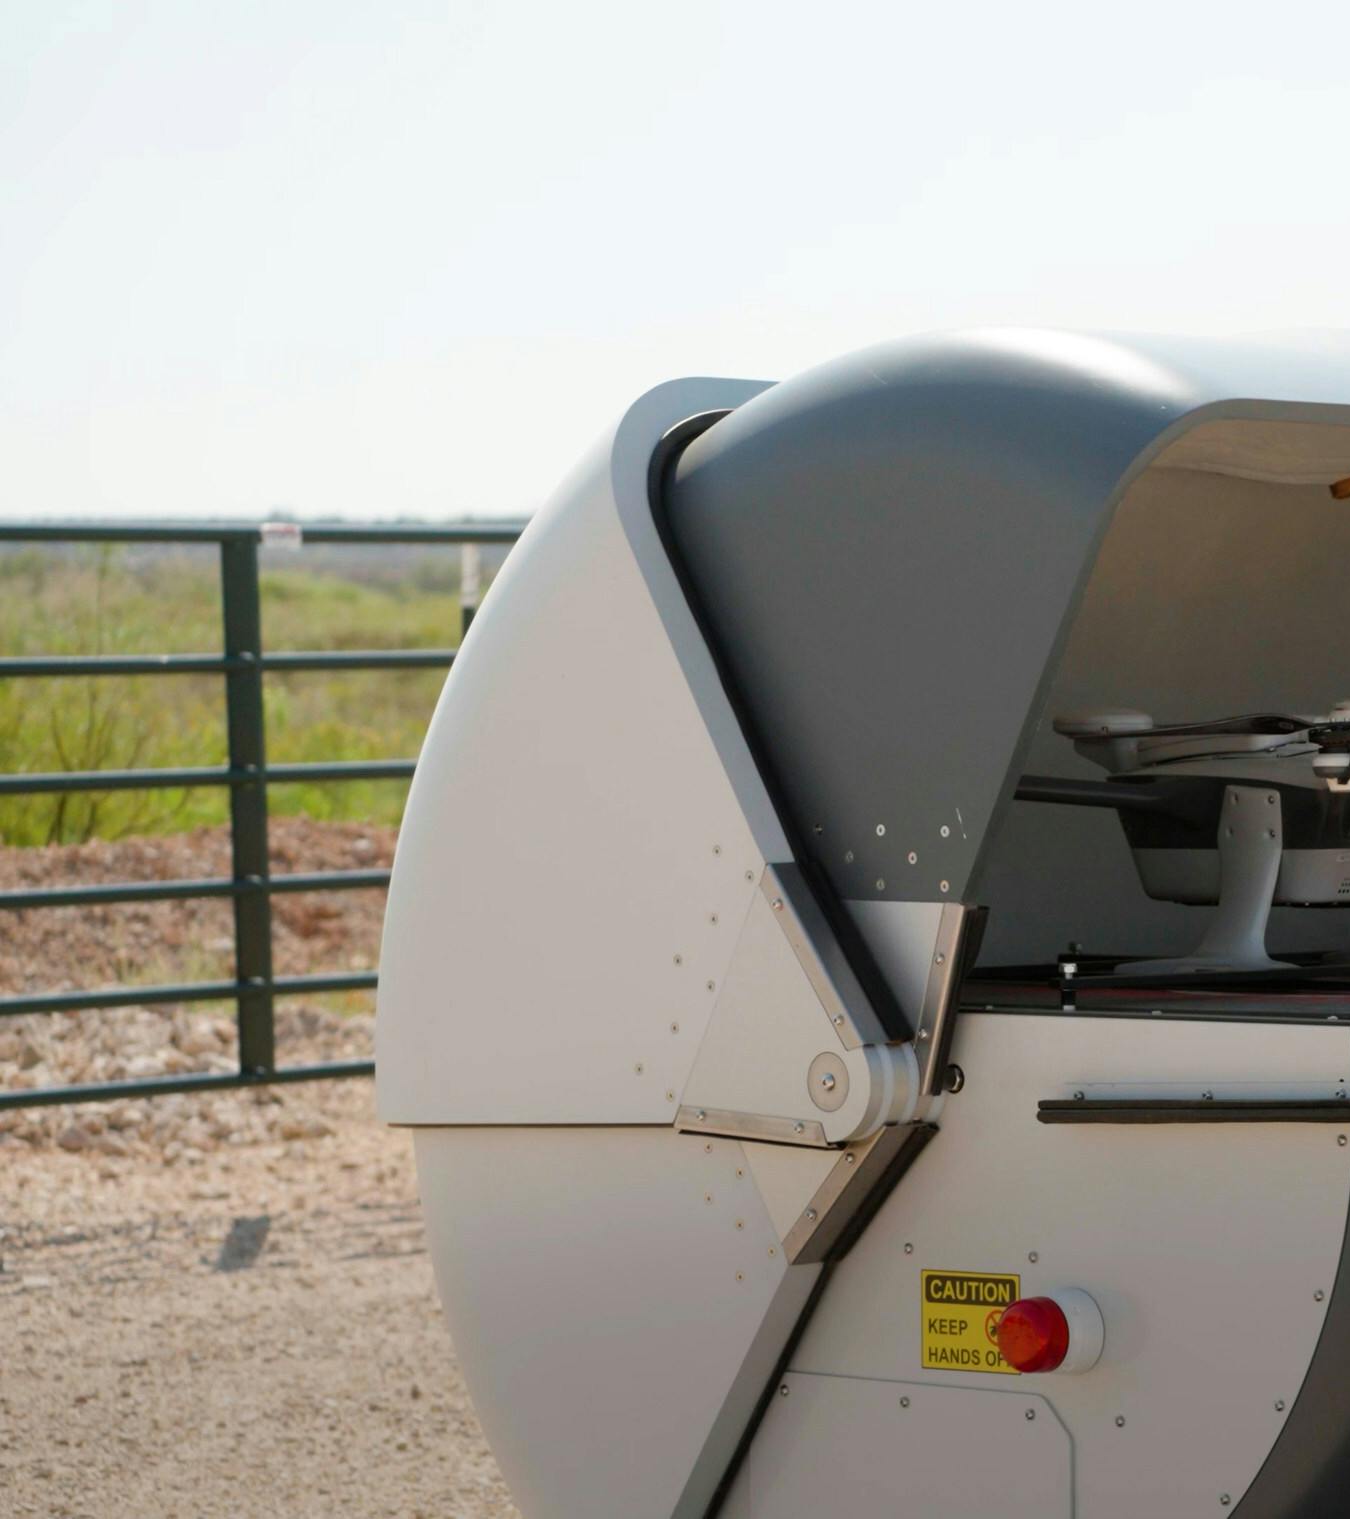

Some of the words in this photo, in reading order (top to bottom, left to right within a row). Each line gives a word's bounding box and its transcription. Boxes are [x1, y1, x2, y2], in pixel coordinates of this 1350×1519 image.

[930, 1279, 1010, 1302] CAUTION
[928, 1318, 968, 1336] KEEP
[928, 1347, 981, 1366] HANDS
[985, 1350, 1011, 1368] OF
